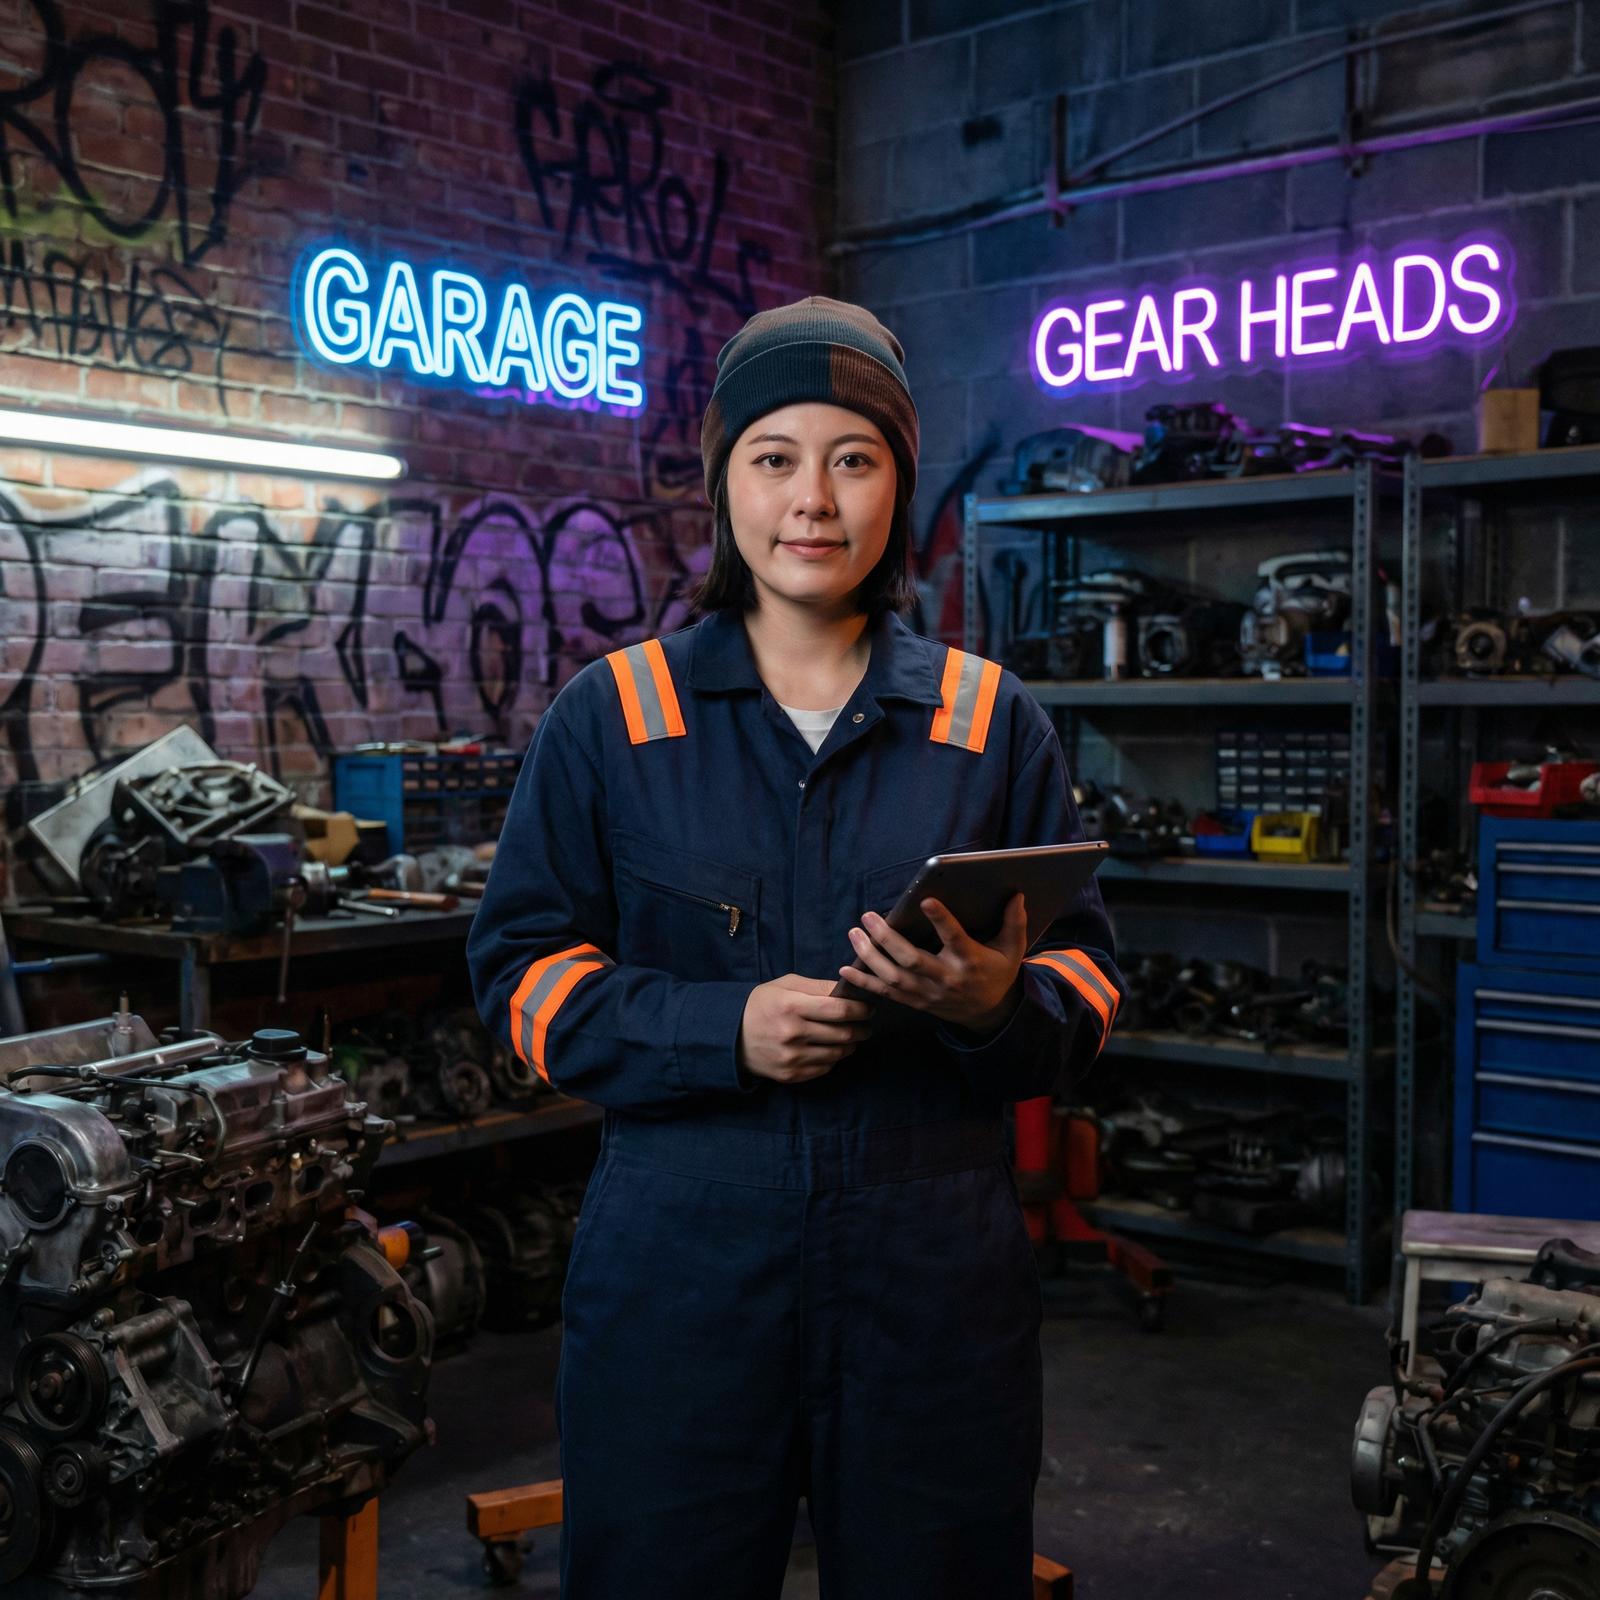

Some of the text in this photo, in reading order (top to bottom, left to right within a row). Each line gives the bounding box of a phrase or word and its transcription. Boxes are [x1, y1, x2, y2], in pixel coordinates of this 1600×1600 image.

[303, 247, 643, 407] GARAGE
[1034, 243, 1502, 389] GEAR HEADS
